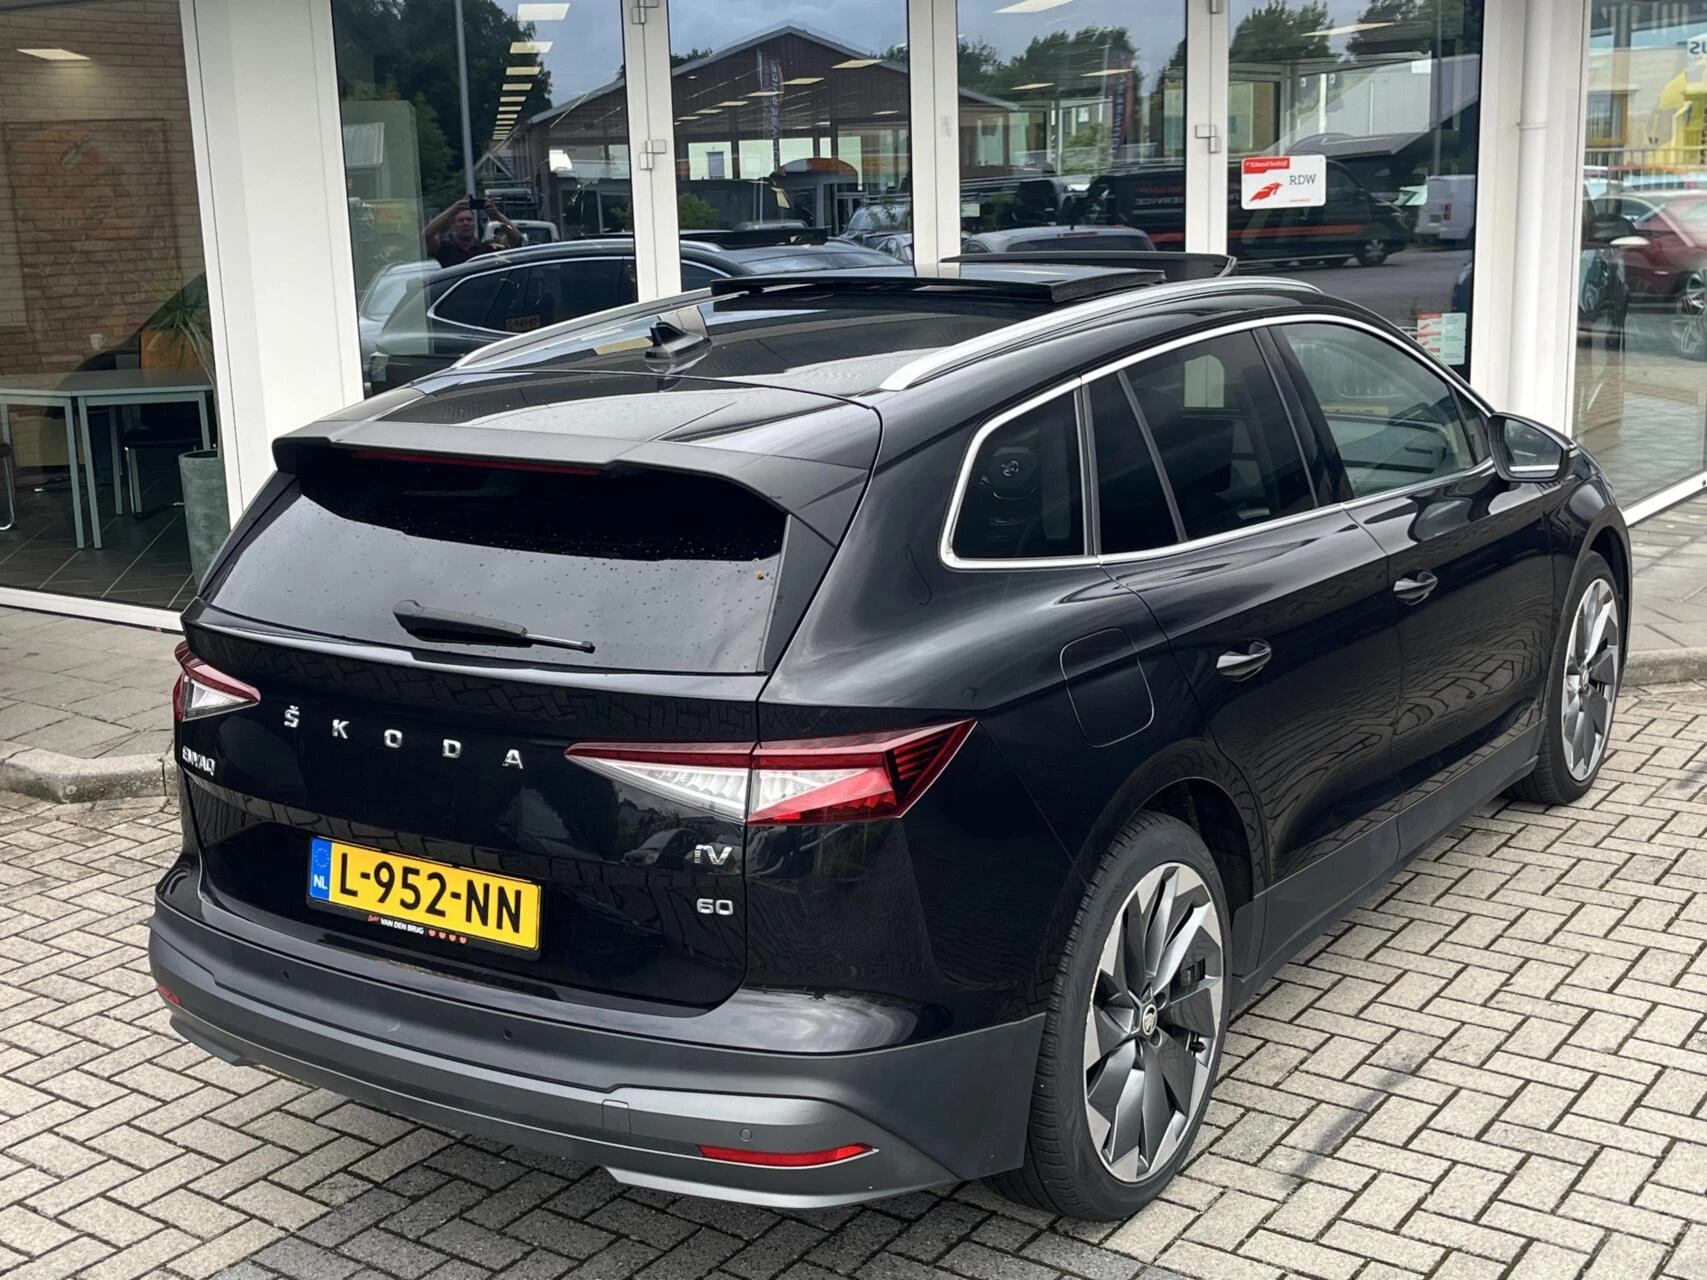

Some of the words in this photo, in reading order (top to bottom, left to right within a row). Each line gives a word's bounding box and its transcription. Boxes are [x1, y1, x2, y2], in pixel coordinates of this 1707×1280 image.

[1289, 174, 1316, 186] RDW
[284, 704, 524, 770] ŠKODA
[182, 745, 216, 776] ENYAQ
[313, 873, 329, 891] NL
[340, 853, 521, 933] L-952-NN
[696, 898, 734, 916] 60
[380, 918, 394, 927] VAN
[394, 921, 407, 930] DEN
[407, 924, 424, 934] BRUG
